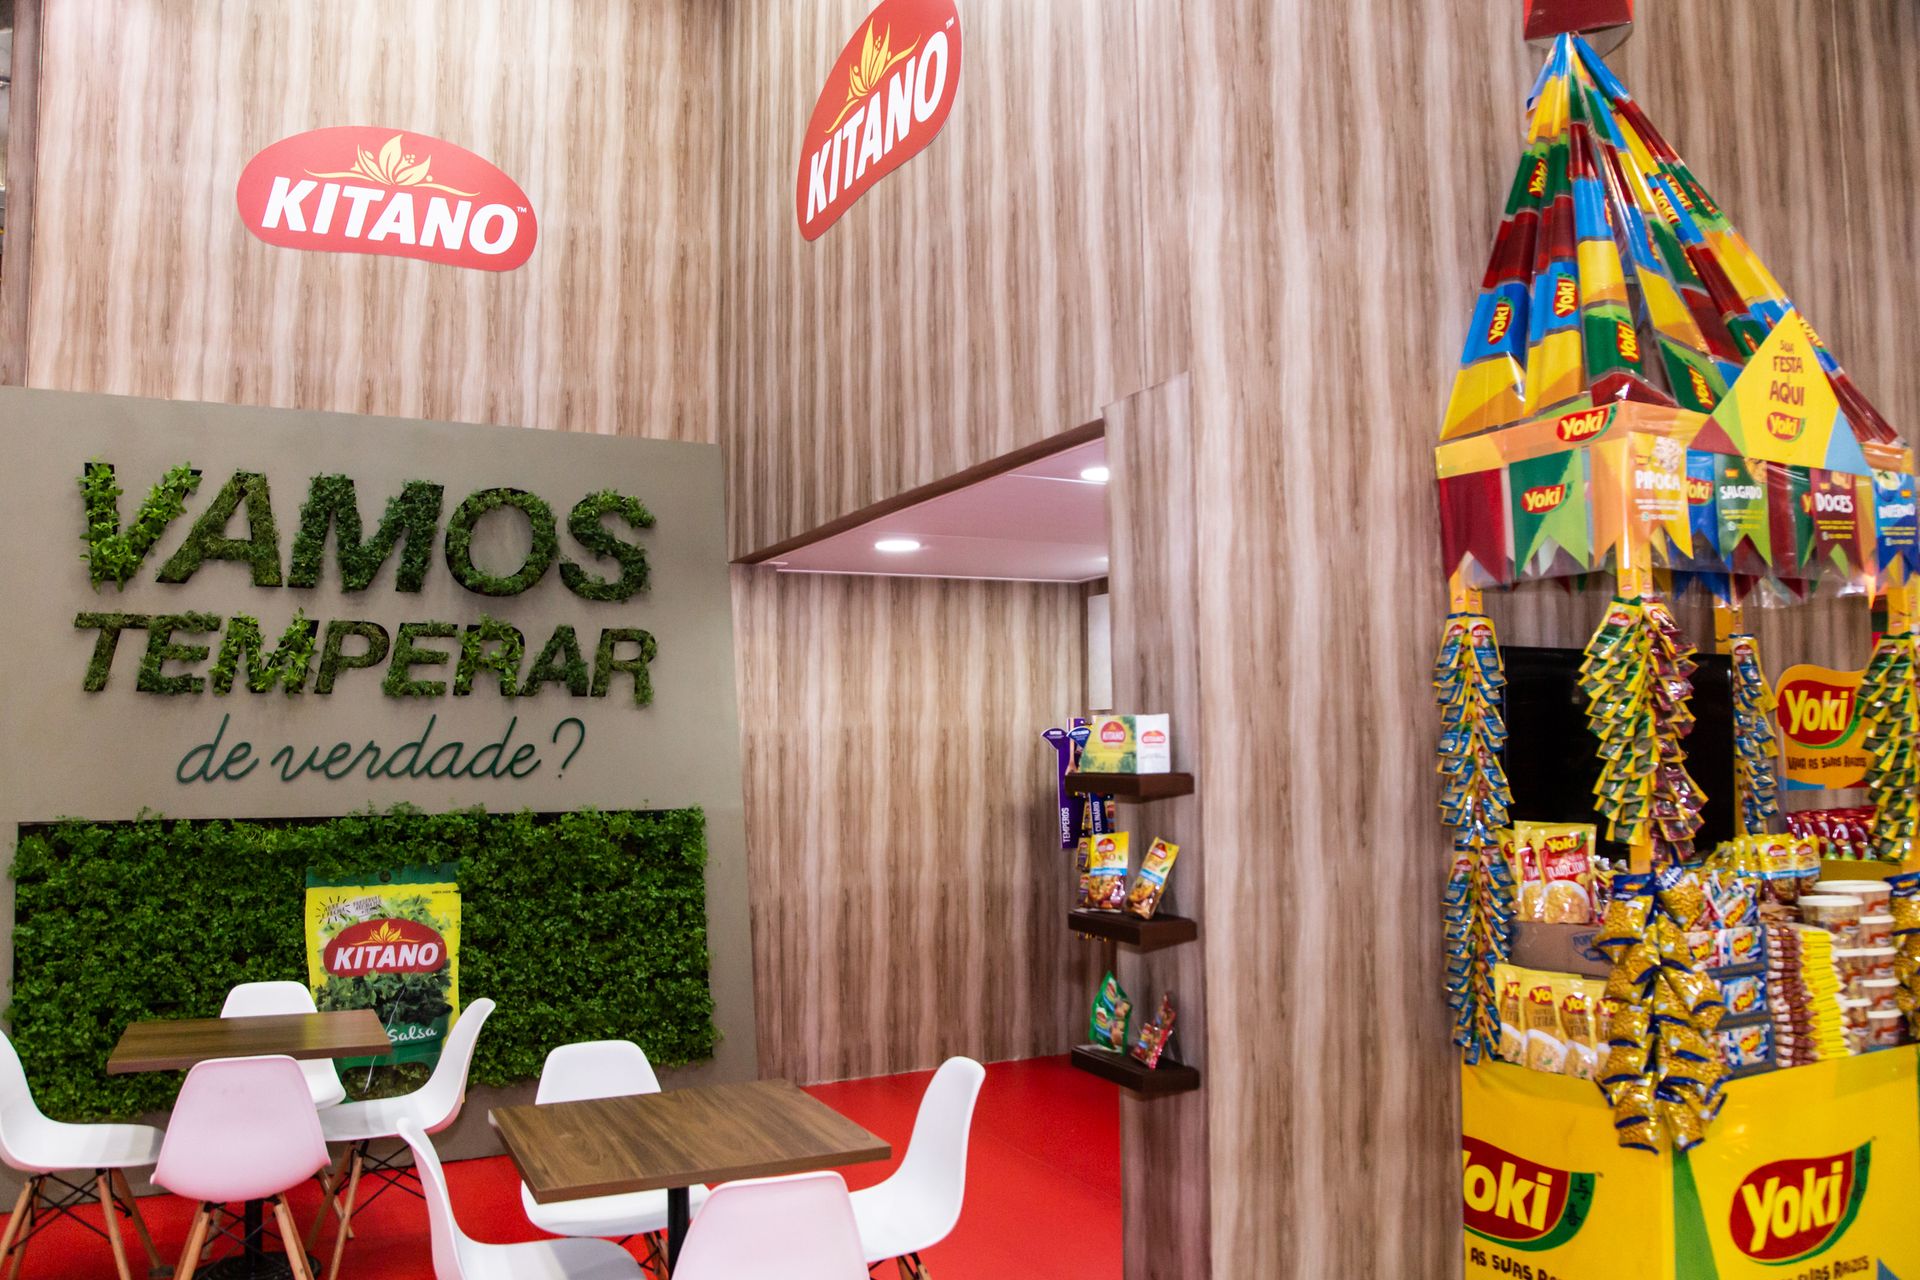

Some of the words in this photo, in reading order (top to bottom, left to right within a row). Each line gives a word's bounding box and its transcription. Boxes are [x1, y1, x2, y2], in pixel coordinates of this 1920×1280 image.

[806, 31, 948, 224] KITANO
[1529, 161, 1548, 194] Yoki
[261, 176, 519, 254] KITANO
[1555, 282, 1576, 316] Yoki
[1488, 306, 1510, 343] Yoki
[1618, 323, 1638, 360] Yoki
[1773, 355, 1803, 373] FESTA
[1689, 367, 1714, 407] Yoki
[1769, 380, 1804, 406] AQUI
[1561, 411, 1604, 440] Yoki
[1770, 414, 1799, 435] Yoki
[1634, 470, 1681, 490] PIPOCA
[1720, 485, 1763, 499] SALGADO
[1524, 487, 1561, 511] Yoki
[1814, 492, 1854, 513] DOCES
[80, 462, 656, 602] VAMOS
[74, 610, 657, 704] TEMPERAR
[1784, 689, 1849, 735] Yoki
[176, 713, 259, 784] de
[270, 714, 586, 781] verdade?
[1061, 807, 1071, 843] TEMPEROS
[1546, 837, 1577, 853] Yoki
[333, 943, 439, 971] KITANO
[389, 1025, 438, 1043] Salsa
[1741, 1160, 1844, 1253] Yoki
[1471, 1247, 1487, 1267] AS
[1491, 1254, 1533, 1280] SUAS
